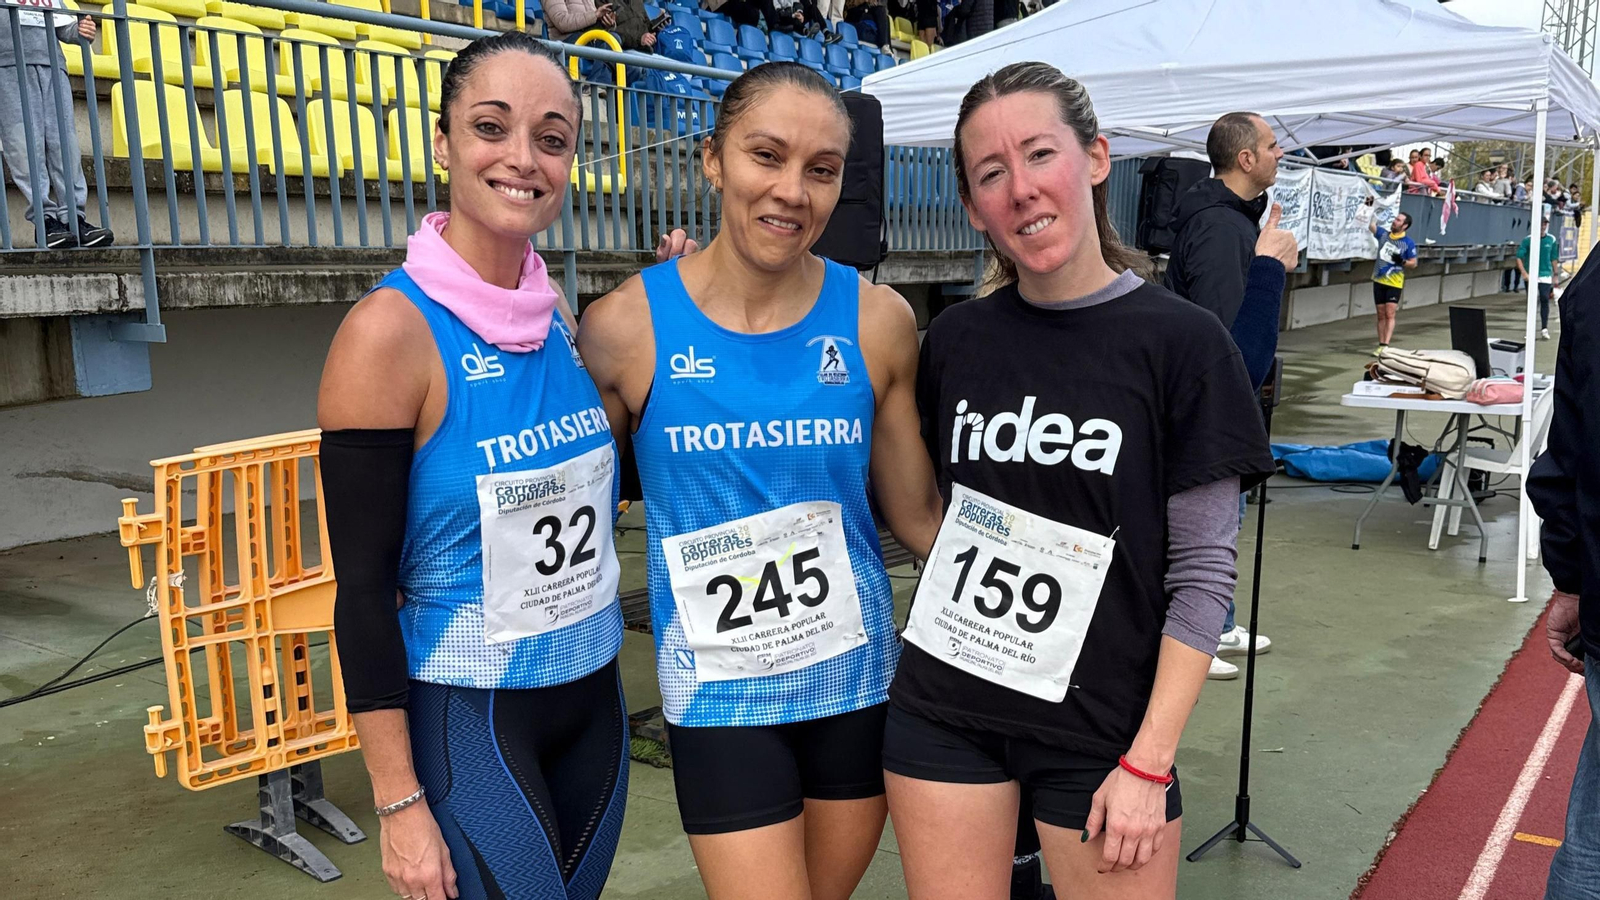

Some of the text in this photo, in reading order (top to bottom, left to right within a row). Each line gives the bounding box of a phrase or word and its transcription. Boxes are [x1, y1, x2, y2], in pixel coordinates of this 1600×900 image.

[461, 342, 505, 381] als
[670, 345, 716, 379] als
[664, 418, 863, 453] TROTASIERRA
[951, 396, 1122, 475] indea
[495, 478, 557, 496] carreras
[496, 483, 566, 508] populares
[498, 504, 532, 515] Diputación
[542, 496, 566, 506] Córdoba
[962, 500, 1004, 525] carreras
[955, 518, 978, 532] Diputación
[985, 532, 1007, 546] Córdoba
[958, 507, 1011, 537] populares
[532, 505, 596, 576] 32
[679, 528, 737, 547] CIRCUITO PROVINCIAL
[681, 533, 739, 555] carreras
[682, 538, 753, 566] populares
[685, 559, 718, 572] Diputación
[728, 549, 756, 560] Córdoba
[520, 597, 550, 610] CIUDAD
[563, 586, 586, 599] PALMA
[524, 587, 540, 597] XLII
[542, 576, 575, 593] CARRERA
[706, 547, 829, 633] 245
[951, 545, 1062, 634] 159
[561, 600, 592, 615] DEPORTIVO
[731, 612, 826, 645] XLII CARRERA POPULAR
[731, 620, 834, 653] CIUDAD DE PALMA DEL RÍO
[934, 617, 1036, 664] CIUDAD DE PALMA DEL RÍO
[941, 607, 1034, 650] XLII CARRERA POPULAR
[776, 647, 815, 663] DEPORTIVO
[961, 651, 1003, 671] DEPORTIVO
[962, 645, 1005, 666] PATRONATO
